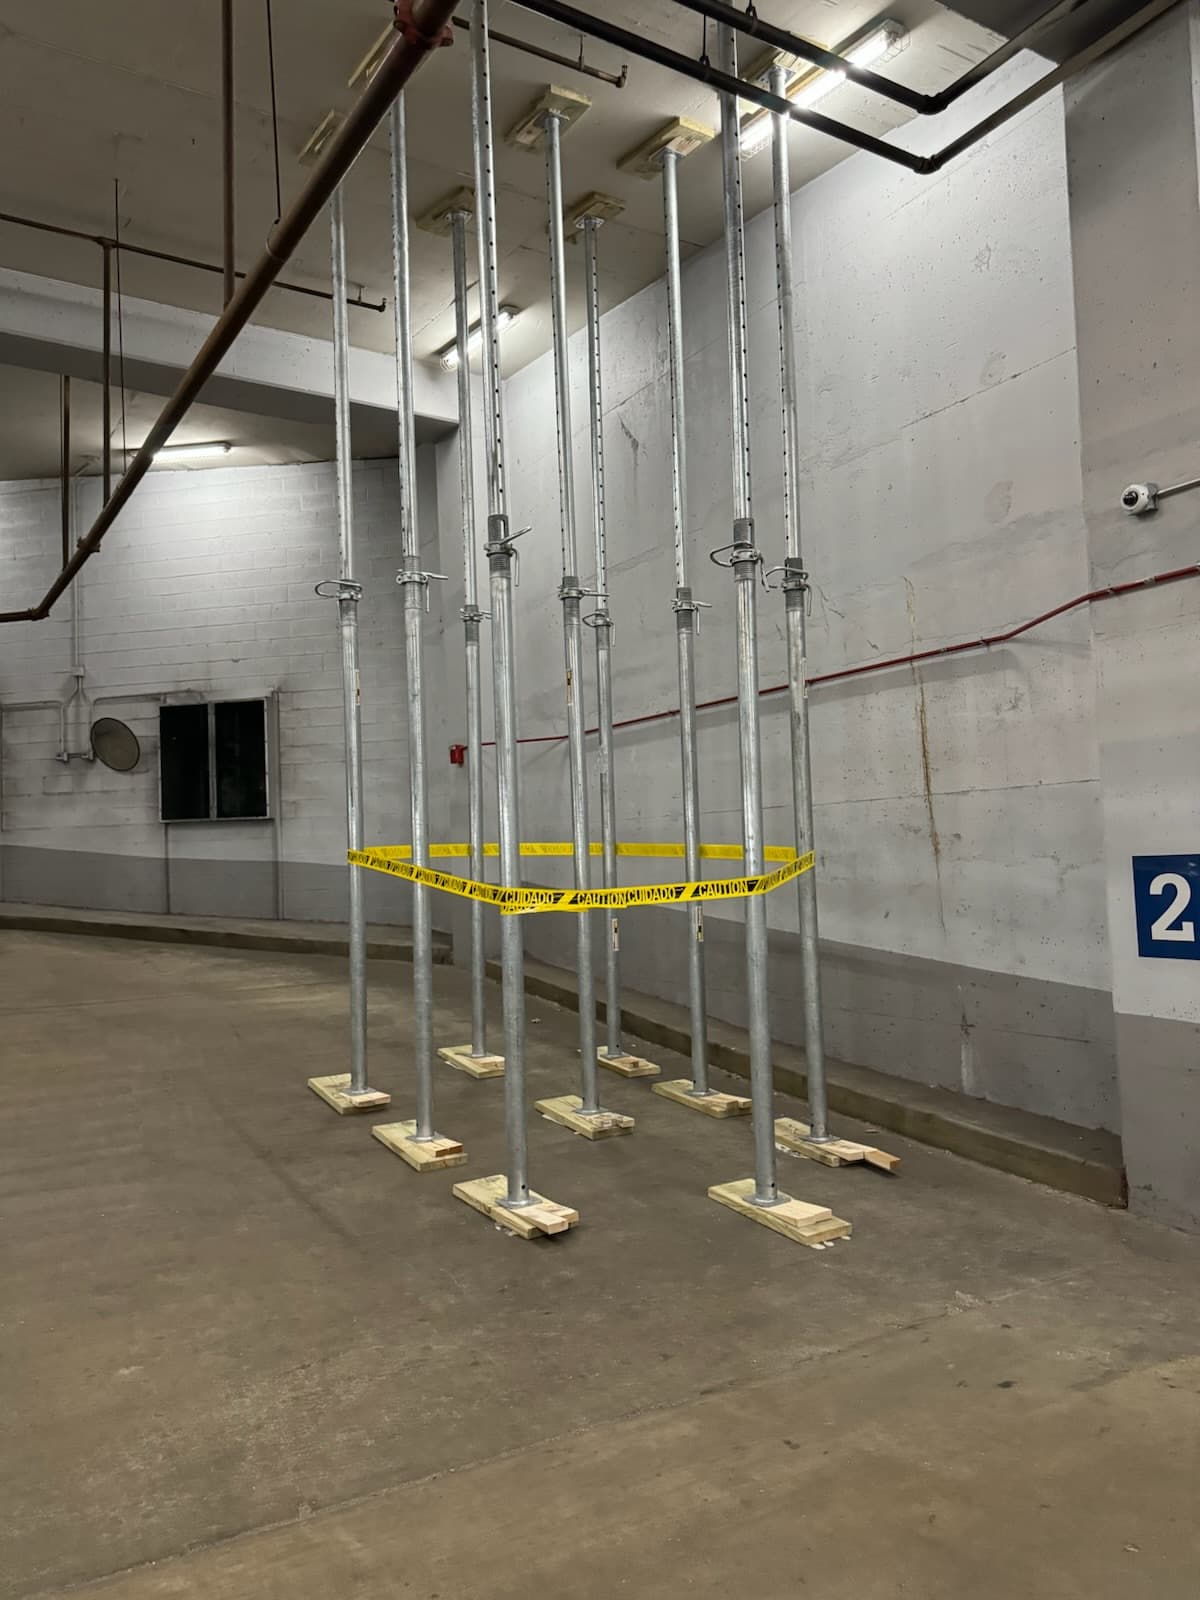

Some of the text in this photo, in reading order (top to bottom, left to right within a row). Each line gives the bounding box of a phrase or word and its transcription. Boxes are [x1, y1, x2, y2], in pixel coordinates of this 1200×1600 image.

[505, 880, 749, 905] CUIDADO CAUTION CUIDADO CAUTION
[1150, 873, 1195, 942] 2
